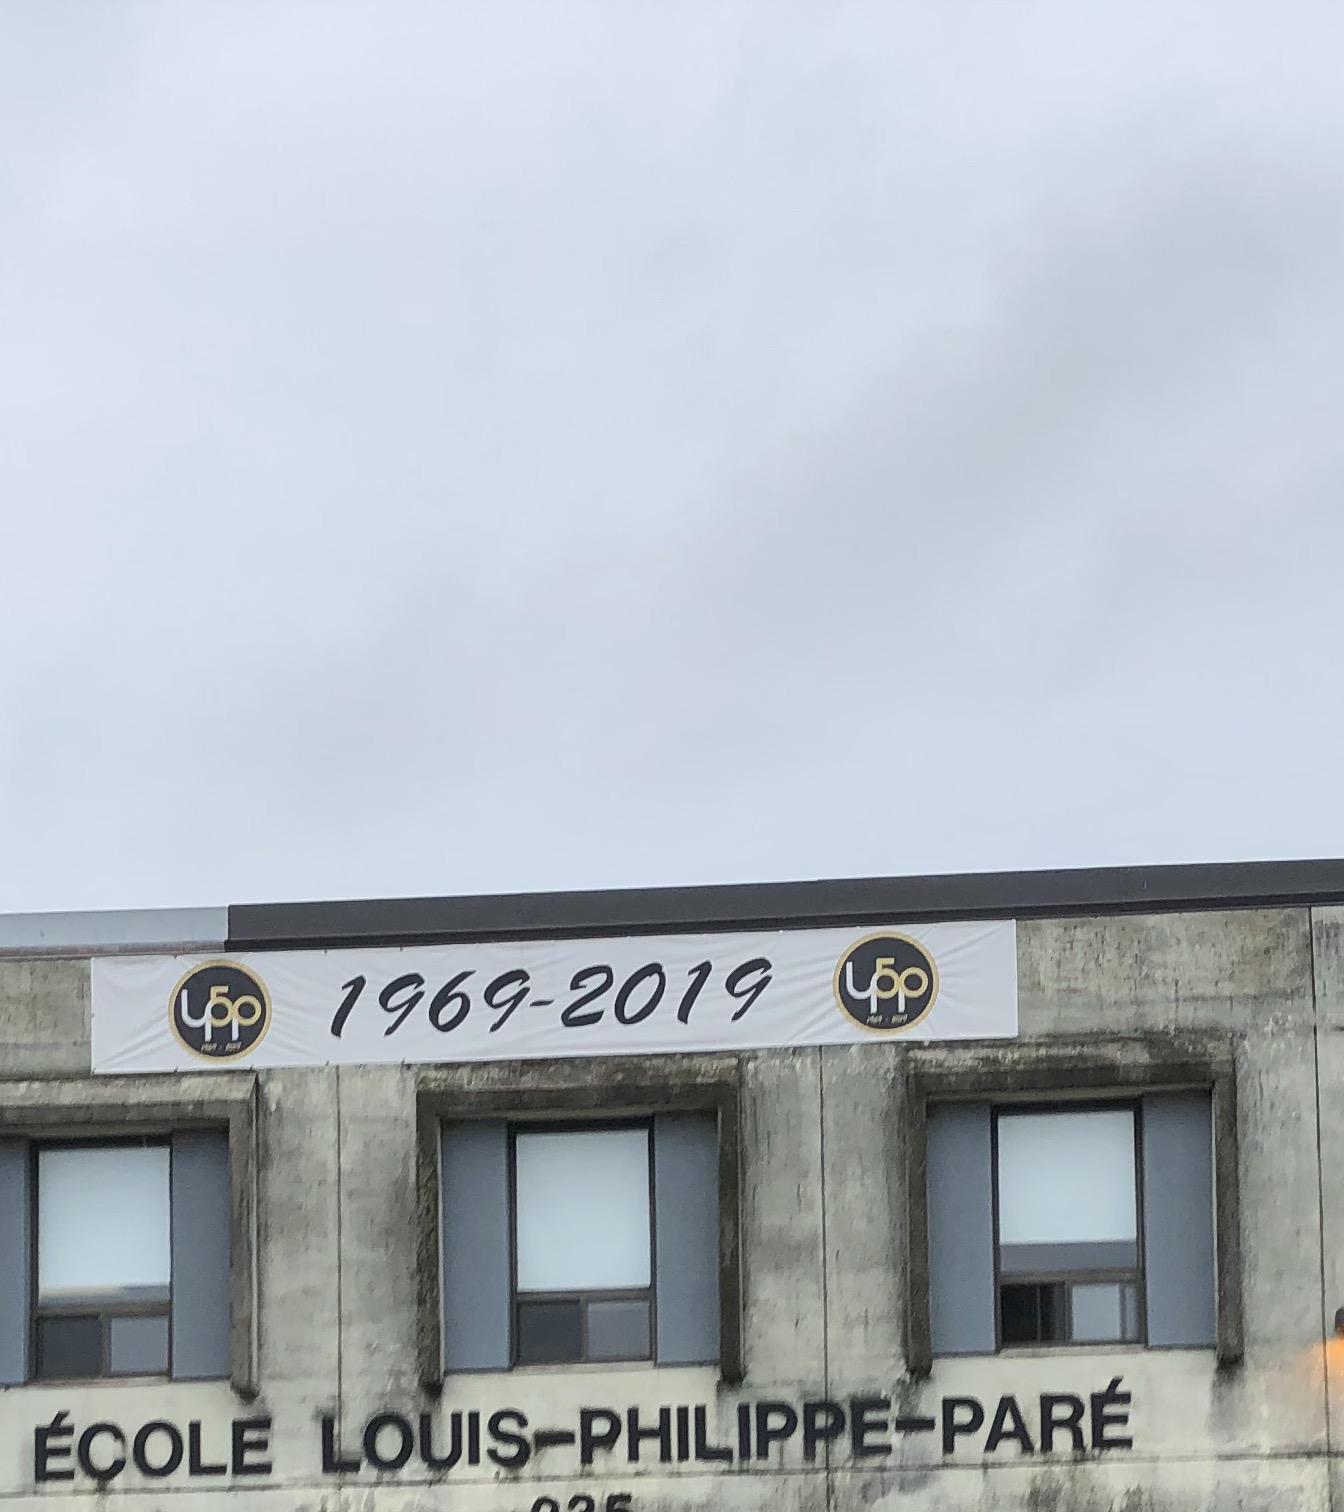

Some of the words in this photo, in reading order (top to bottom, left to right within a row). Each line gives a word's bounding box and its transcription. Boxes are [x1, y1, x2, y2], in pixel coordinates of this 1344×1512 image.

[330, 956, 774, 1039] 1969-2019
[34, 1410, 273, 1482] ÉCOLE
[321, 1376, 1134, 1473] LOUIS-PHILIPPE-PARÉ
